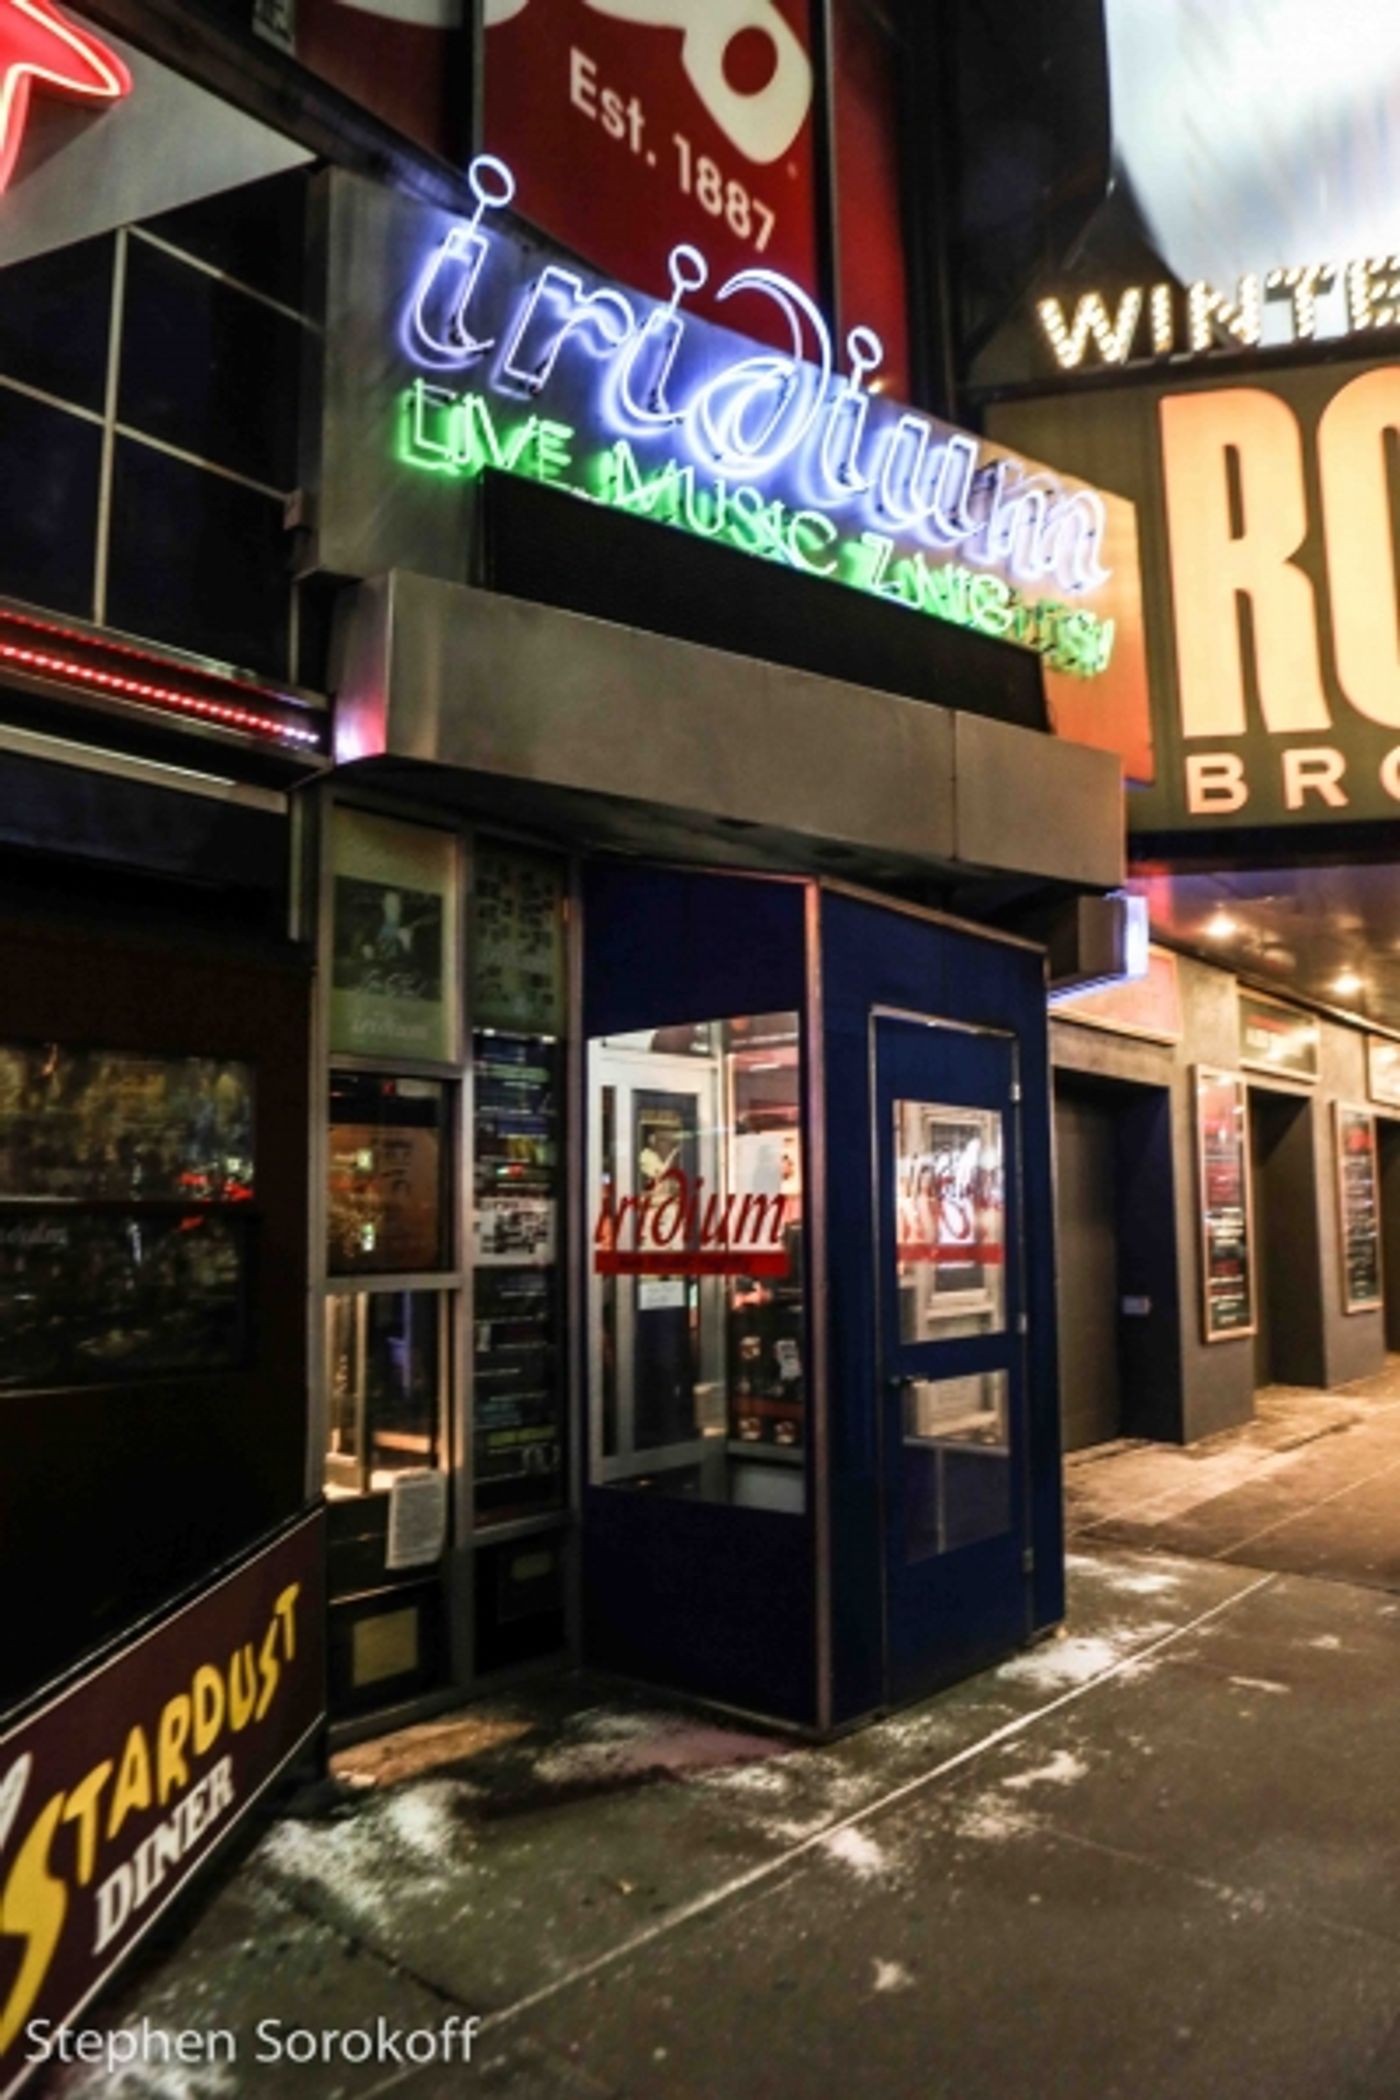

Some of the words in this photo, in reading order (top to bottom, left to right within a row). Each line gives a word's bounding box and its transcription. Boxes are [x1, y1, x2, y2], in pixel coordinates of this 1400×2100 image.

[570, 46, 656, 167] Est.
[672, 132, 775, 252] 1887
[402, 154, 1113, 593] iridium
[399, 378, 590, 502] LIVE
[592, 438, 838, 575] MUSIC
[593, 1168, 787, 1247] iridium
[0, 1582, 299, 2058] STARDUST
[93, 1755, 235, 1956] DINER
